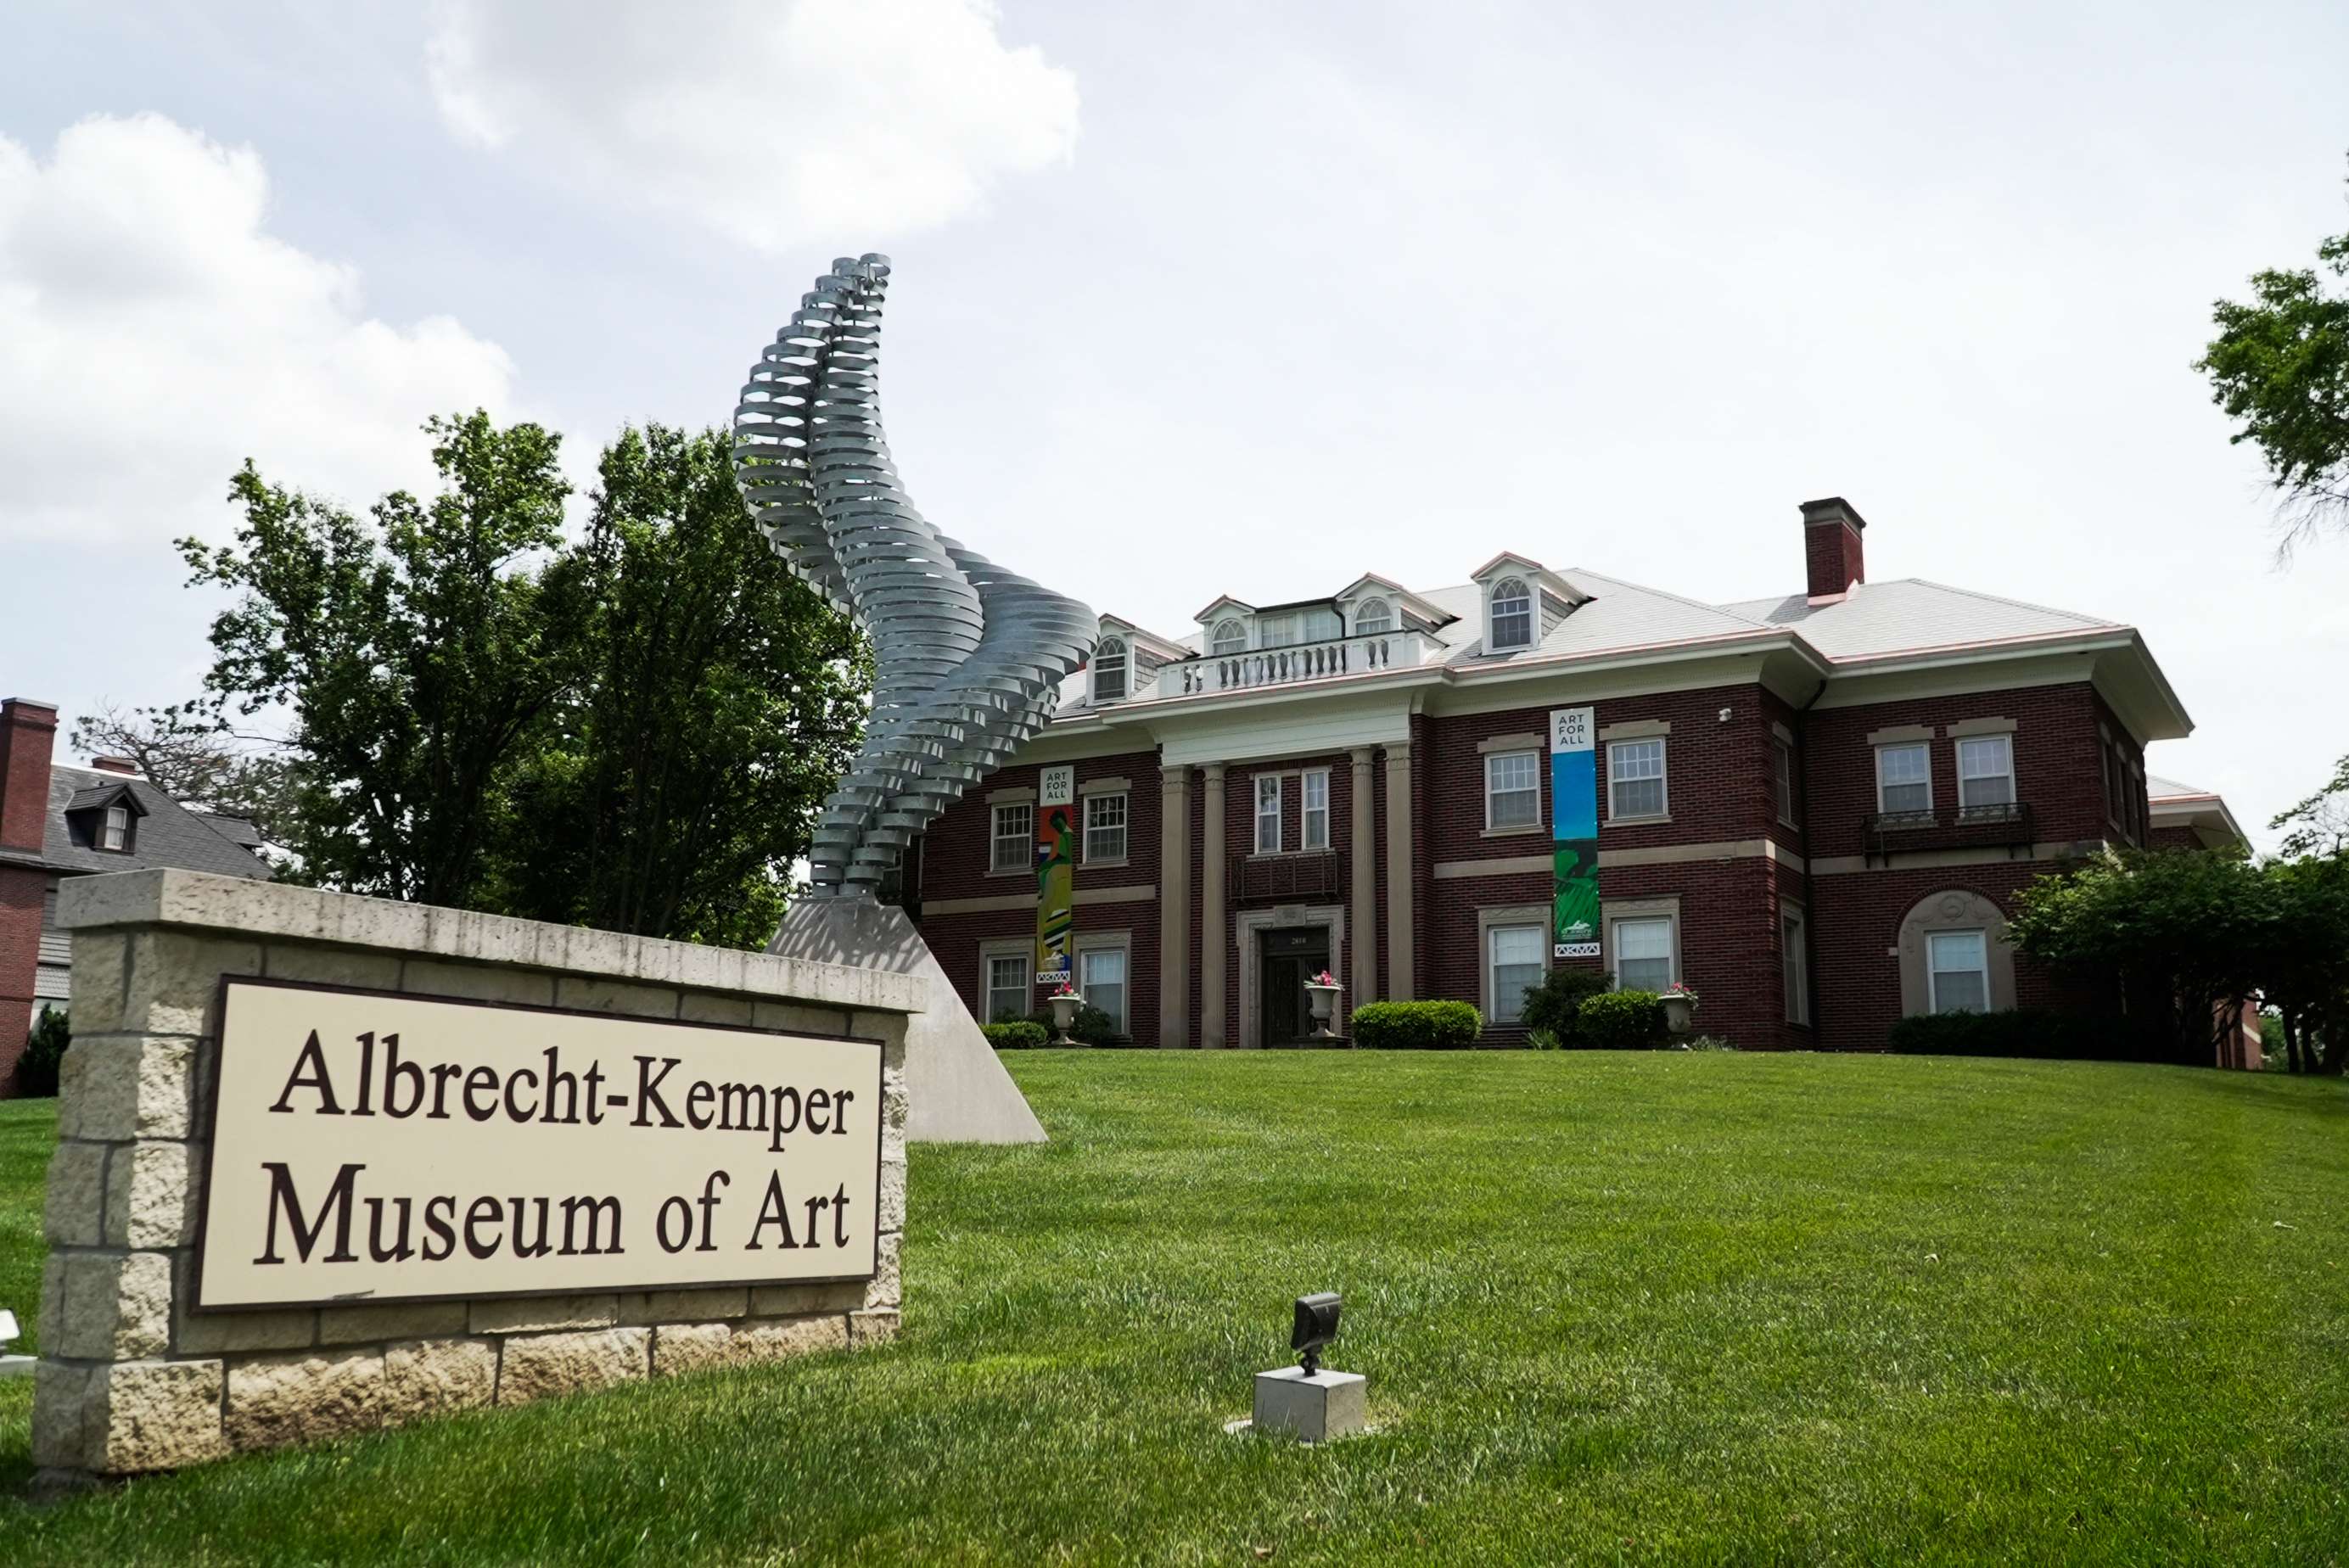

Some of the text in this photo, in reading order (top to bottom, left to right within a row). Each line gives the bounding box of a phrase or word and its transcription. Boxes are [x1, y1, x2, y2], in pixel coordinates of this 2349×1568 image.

[1559, 714, 1584, 725] ART
[1559, 724, 1584, 736] FOR
[1560, 735, 1584, 746] ALL
[1046, 772, 1067, 781] ART
[1046, 781, 1067, 790] FOR
[1046, 791, 1066, 799] ALL
[1556, 945, 1598, 955] AKMA
[268, 1028, 855, 1153] Albrecht-Kemper
[253, 1162, 851, 1265] Museum of Art
